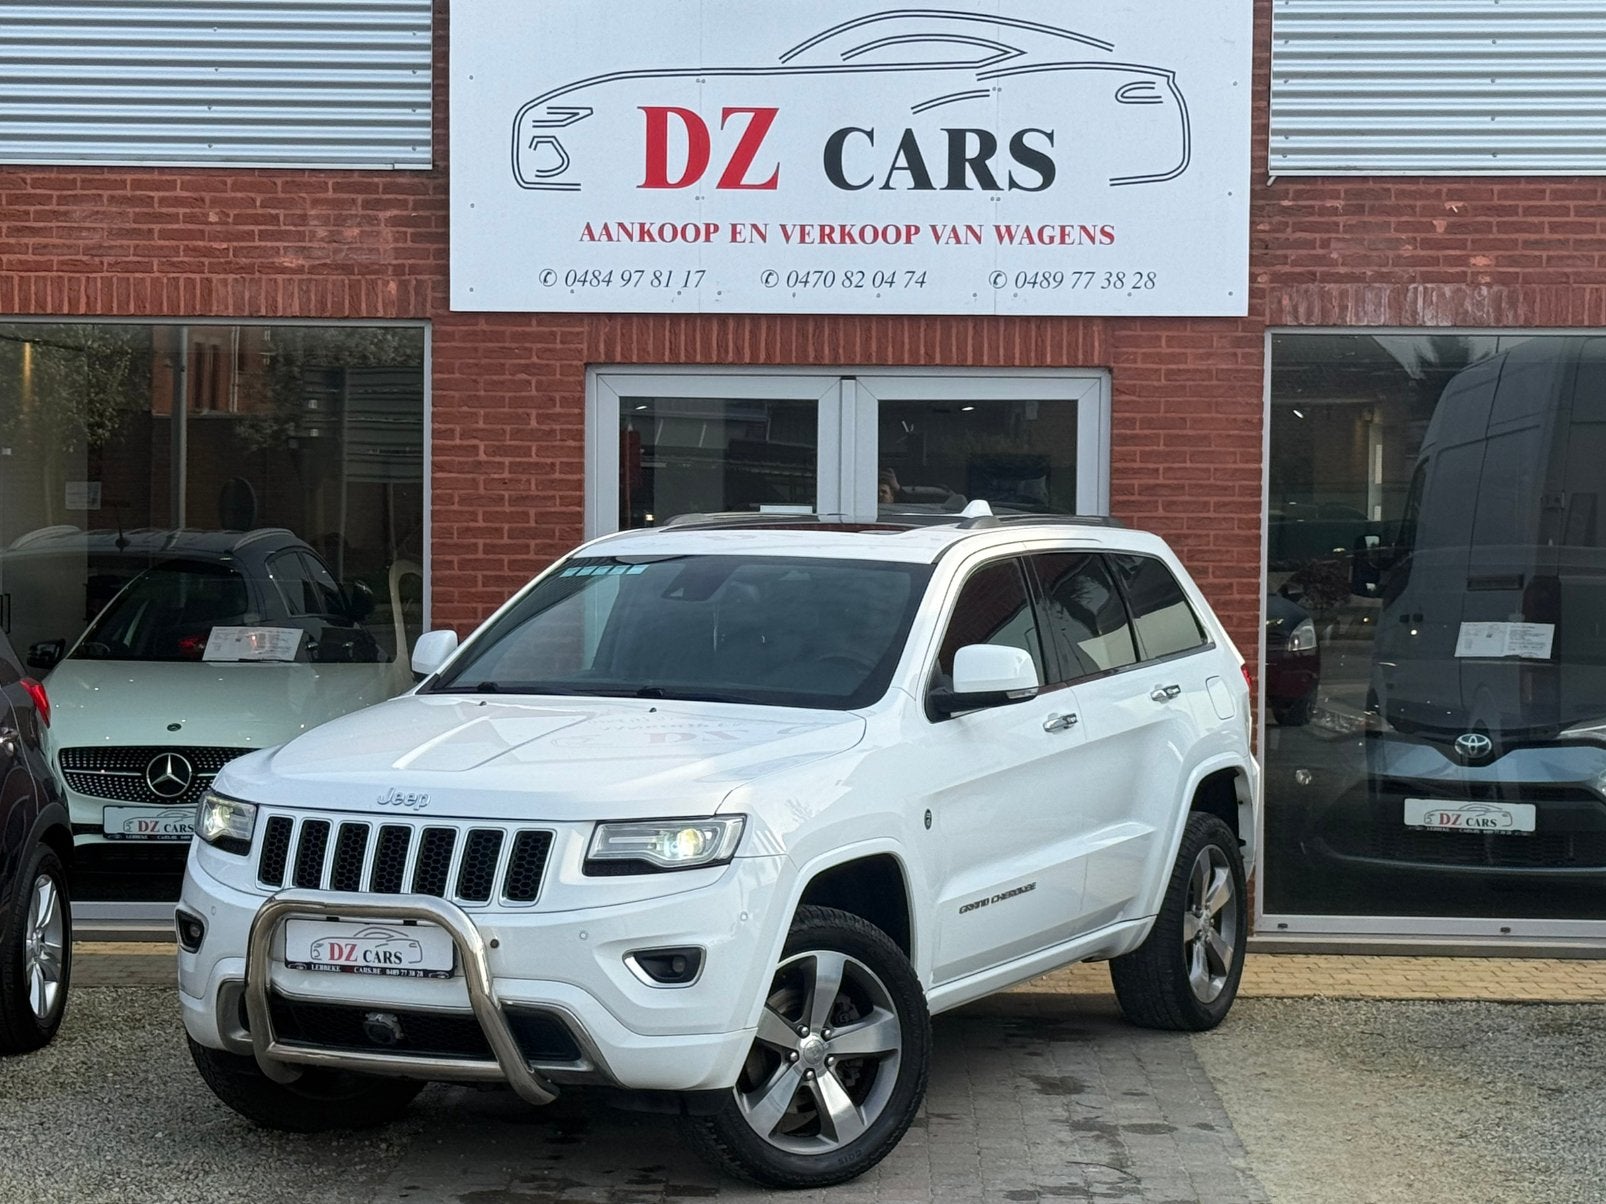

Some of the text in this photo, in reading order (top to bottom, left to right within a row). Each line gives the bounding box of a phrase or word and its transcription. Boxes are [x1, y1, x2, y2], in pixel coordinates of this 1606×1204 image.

[636, 105, 1056, 192] DZ CARS
[579, 222, 1115, 246] AANKOOP EN VERKOOP VAN WAGENS
[565, 270, 706, 288] 0484 97 81 17
[787, 270, 927, 288] 0470 82 04 74
[1015, 271, 1156, 289] 0489 77 38 28
[377, 786, 431, 811] Jeep
[138, 820, 194, 833] DZ CARS
[1439, 812, 1497, 828] DZ CARS
[959, 882, 1037, 914] GRAND CHEROKEE
[328, 943, 402, 965] DZ CARS
